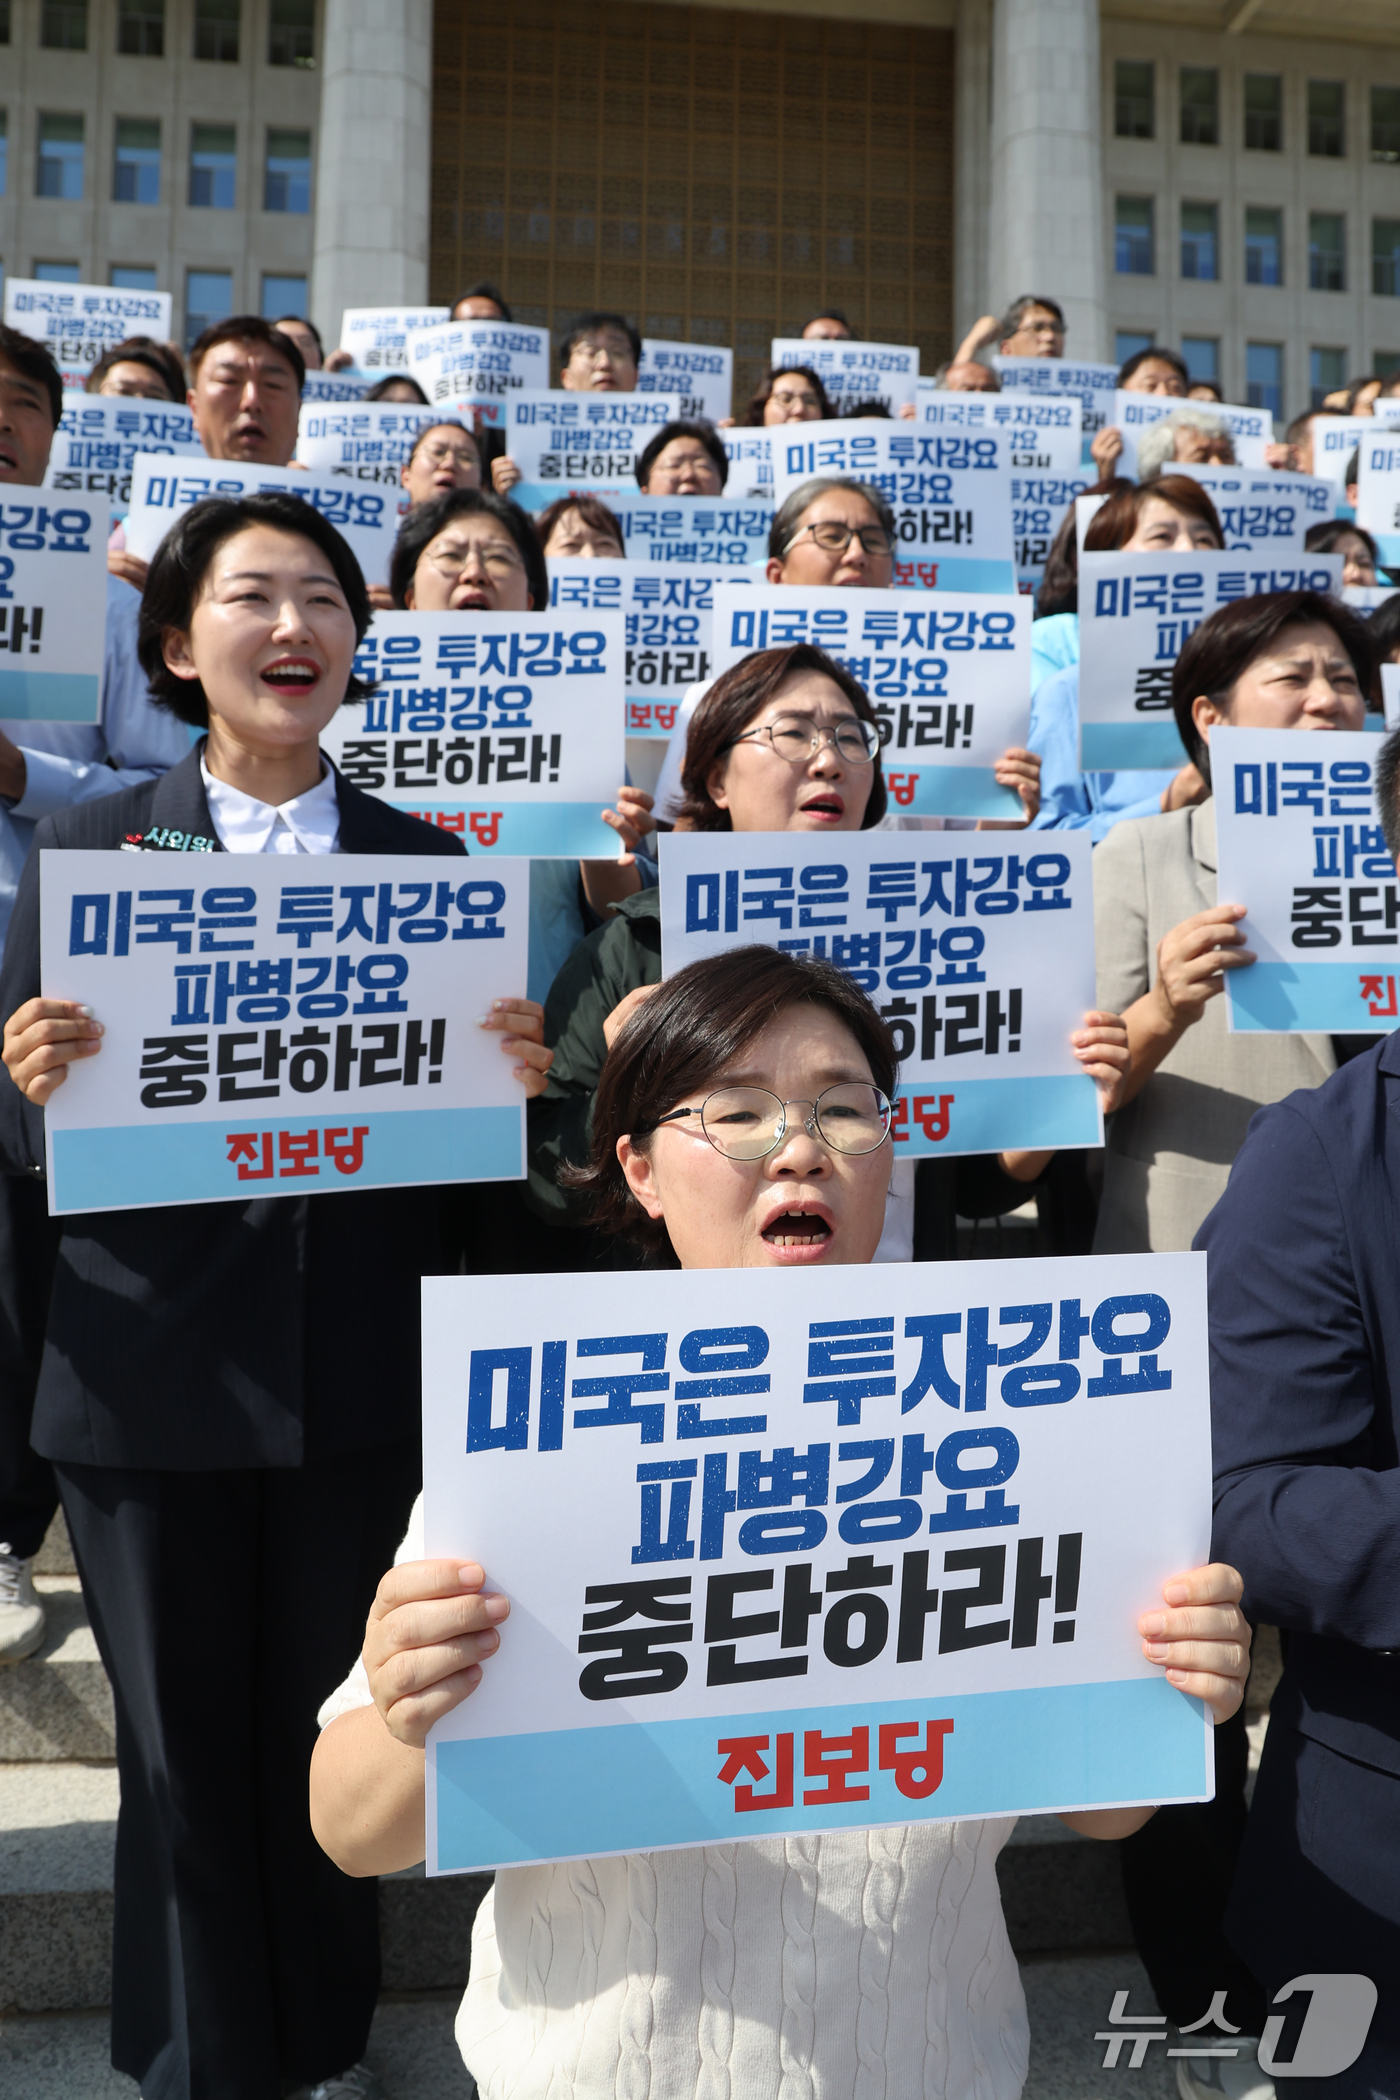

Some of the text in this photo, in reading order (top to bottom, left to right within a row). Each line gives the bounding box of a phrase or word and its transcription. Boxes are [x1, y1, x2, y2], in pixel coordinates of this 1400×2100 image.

[57, 410, 202, 442] 국은 투자강
[307, 415, 370, 437] 미국은
[516, 403, 579, 425] 미국은
[587, 403, 670, 425] 투자강요
[551, 429, 634, 451] 파병강요
[342, 441, 414, 462] 파병강
[786, 437, 878, 475] 미국은
[888, 436, 998, 470] 투자강요
[551, 576, 621, 608] 국은
[1095, 572, 1205, 617] 미국은
[730, 608, 1016, 651] 미국은 투자강요
[352, 631, 607, 682] 국은 투자강요
[361, 684, 533, 734] 파병강요
[340, 734, 562, 790] 중단하라!
[1233, 761, 1374, 817] 미국은
[68, 880, 507, 958] 미국은 투자강요
[684, 853, 1073, 934] 미국은 투자강요
[170, 953, 409, 1026] 파병강요
[139, 1018, 447, 1109] 중단하라!
[226, 1126, 370, 1181] 진보당
[465, 1292, 1174, 1455] 미국은 투자강요
[630, 1425, 1021, 1566] 파병강요
[577, 1532, 1084, 1702] 중단하라!
[716, 1717, 956, 1814] 진보당
